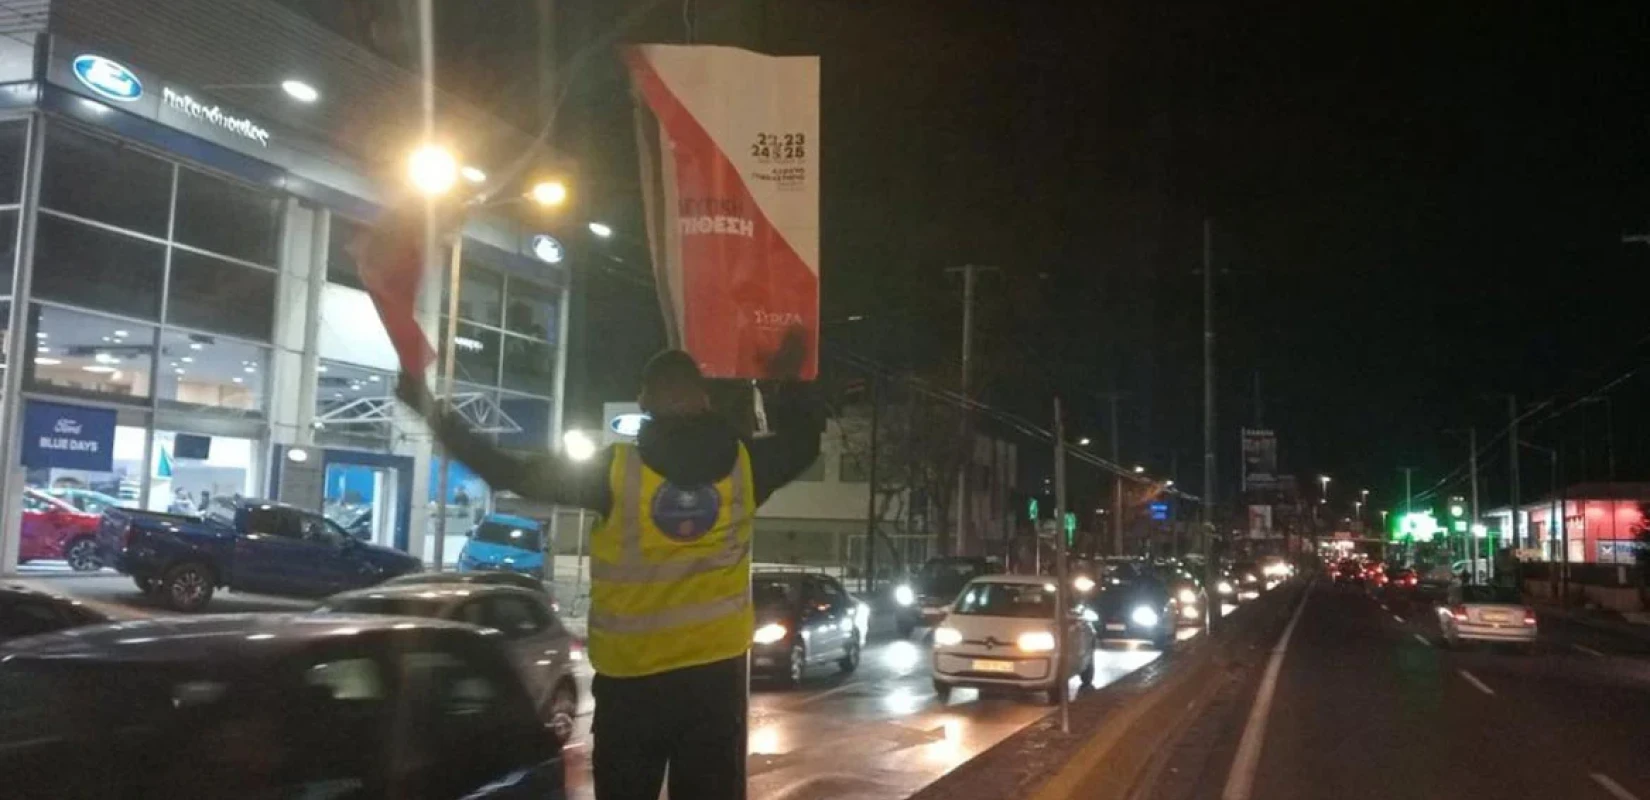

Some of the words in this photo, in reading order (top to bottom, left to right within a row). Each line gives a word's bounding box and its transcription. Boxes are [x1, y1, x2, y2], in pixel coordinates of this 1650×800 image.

[784, 133, 805, 146] 23
[752, 144, 769, 157] 24
[40, 437, 69, 450] BLUE
[69, 440, 99, 453] DAYS
